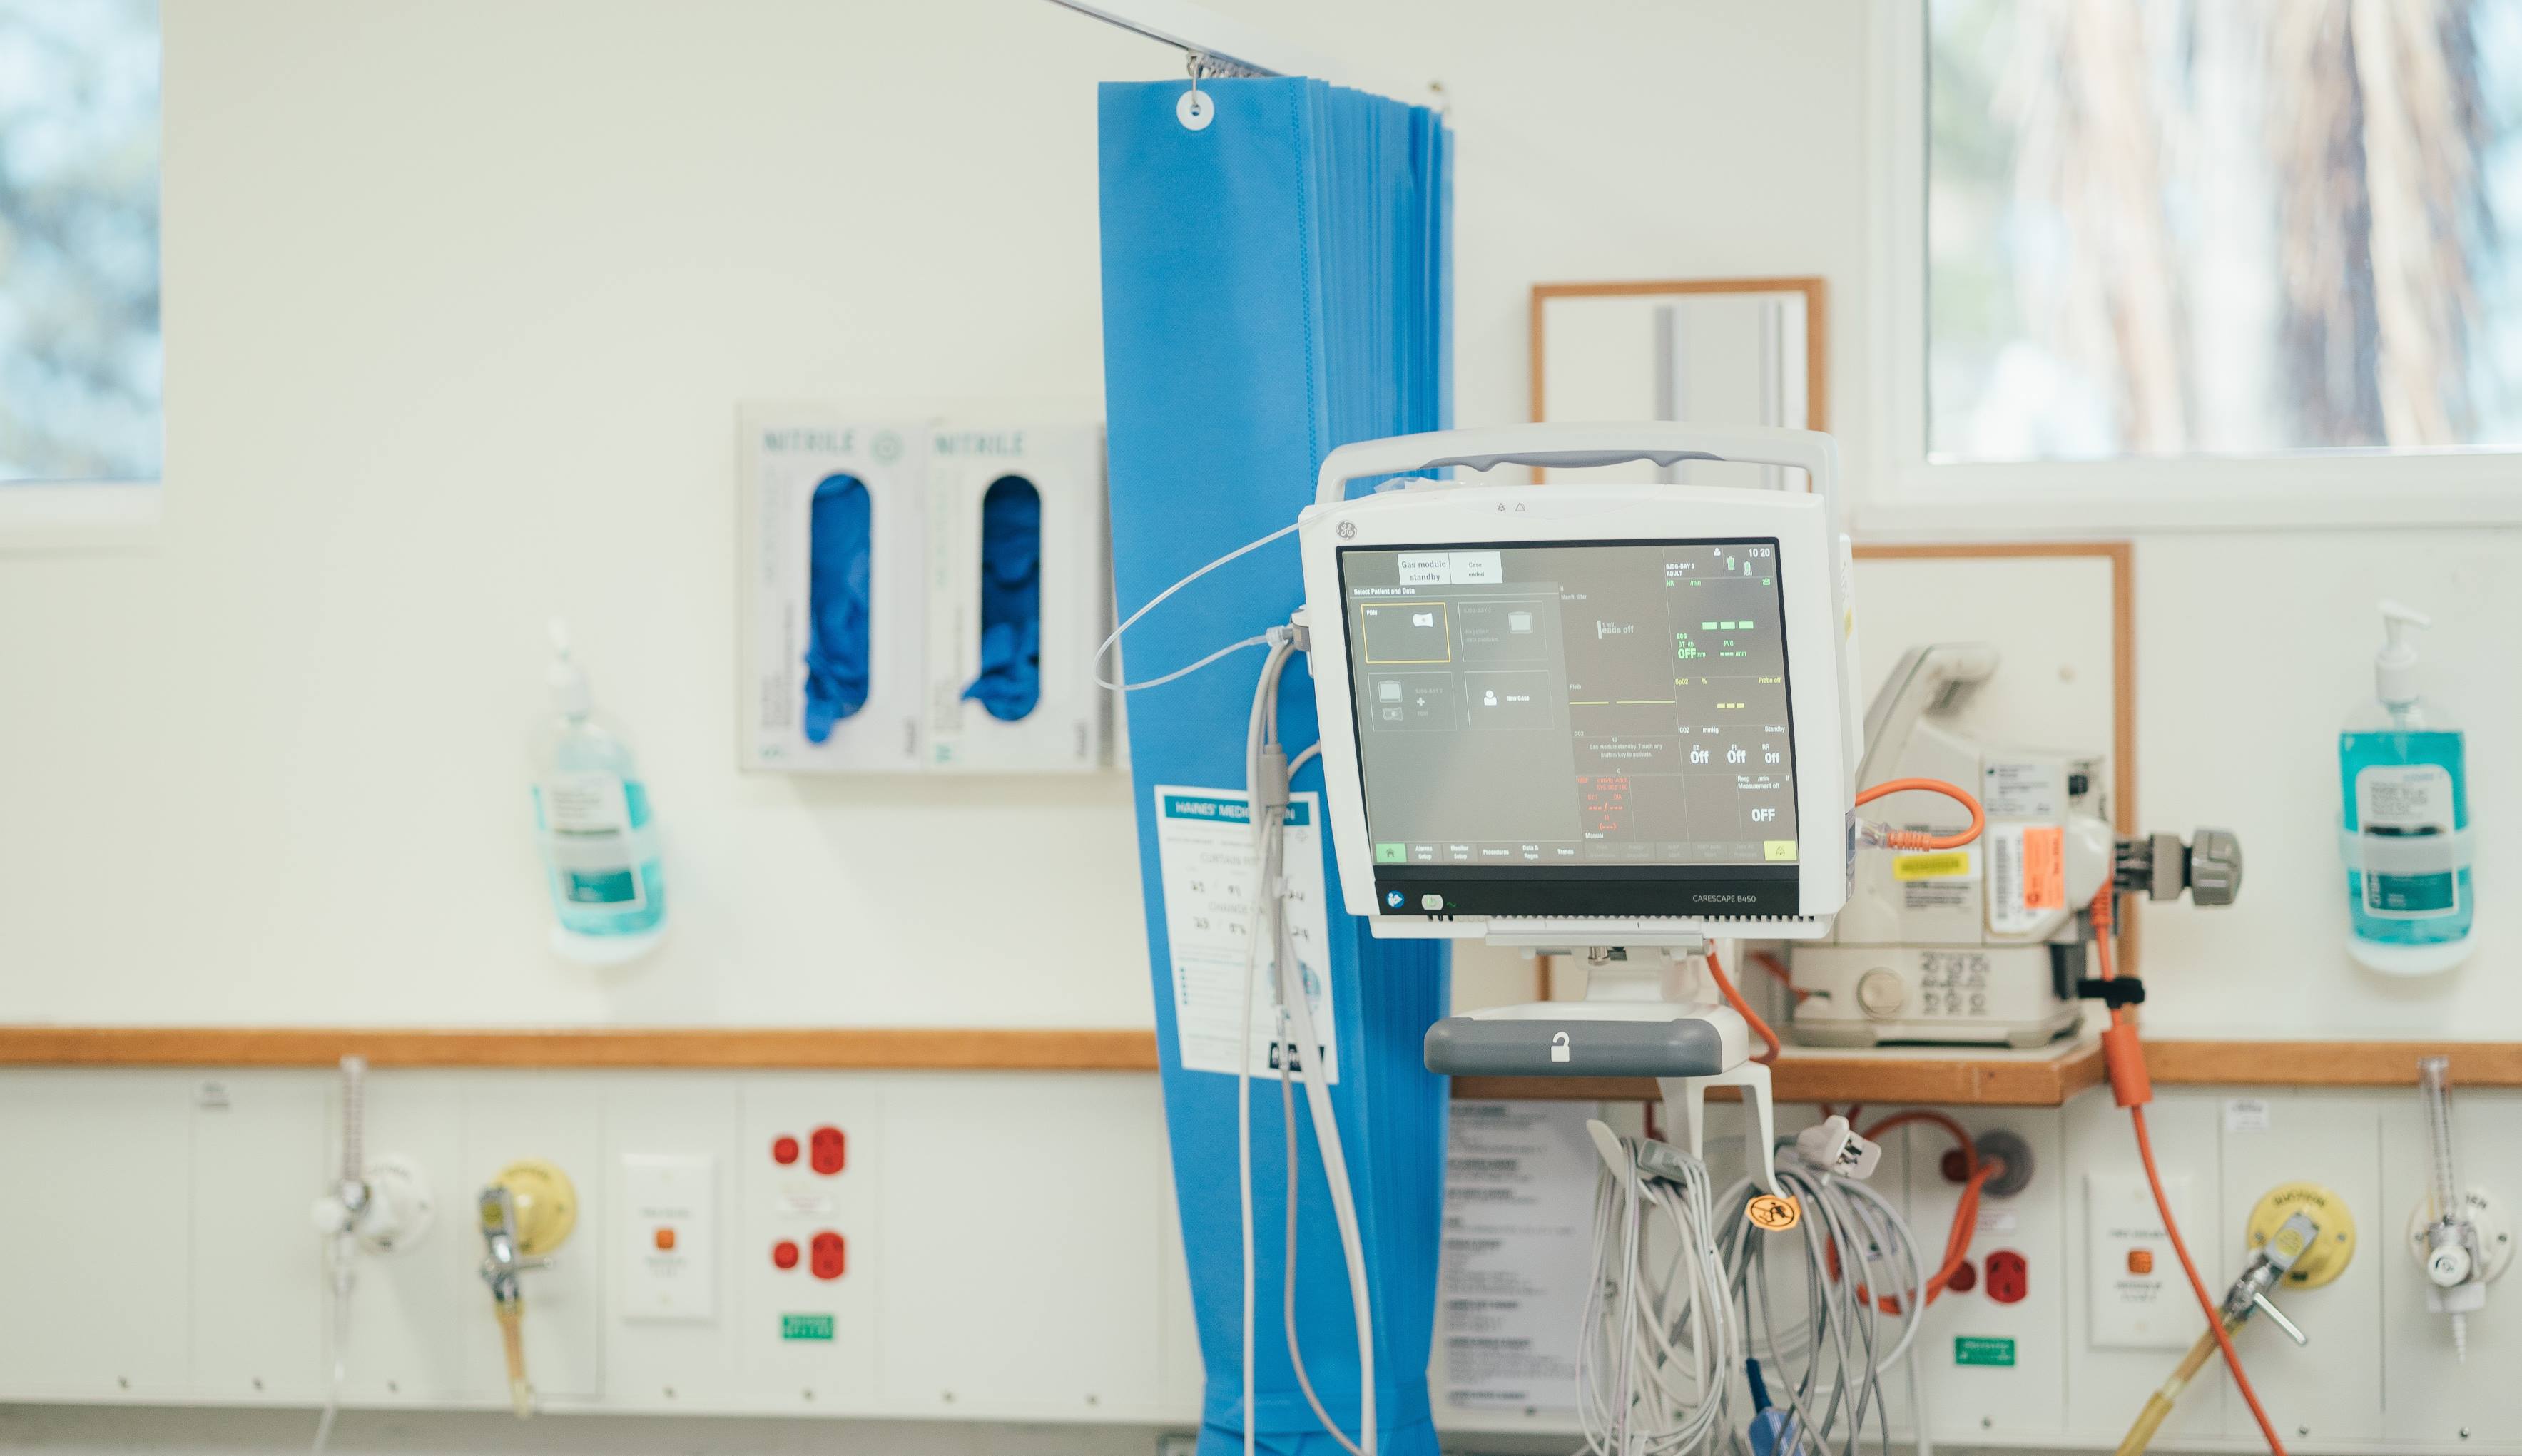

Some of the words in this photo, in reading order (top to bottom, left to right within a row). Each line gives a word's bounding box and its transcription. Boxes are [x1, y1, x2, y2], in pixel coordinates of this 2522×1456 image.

[1410, 573, 1440, 581] standby
[1623, 625, 1634, 633] off
[1690, 751, 1709, 763] Off
[1727, 750, 1746, 763] Off
[1764, 753, 1780, 763] Off
[1752, 808, 1775, 821] OFF
